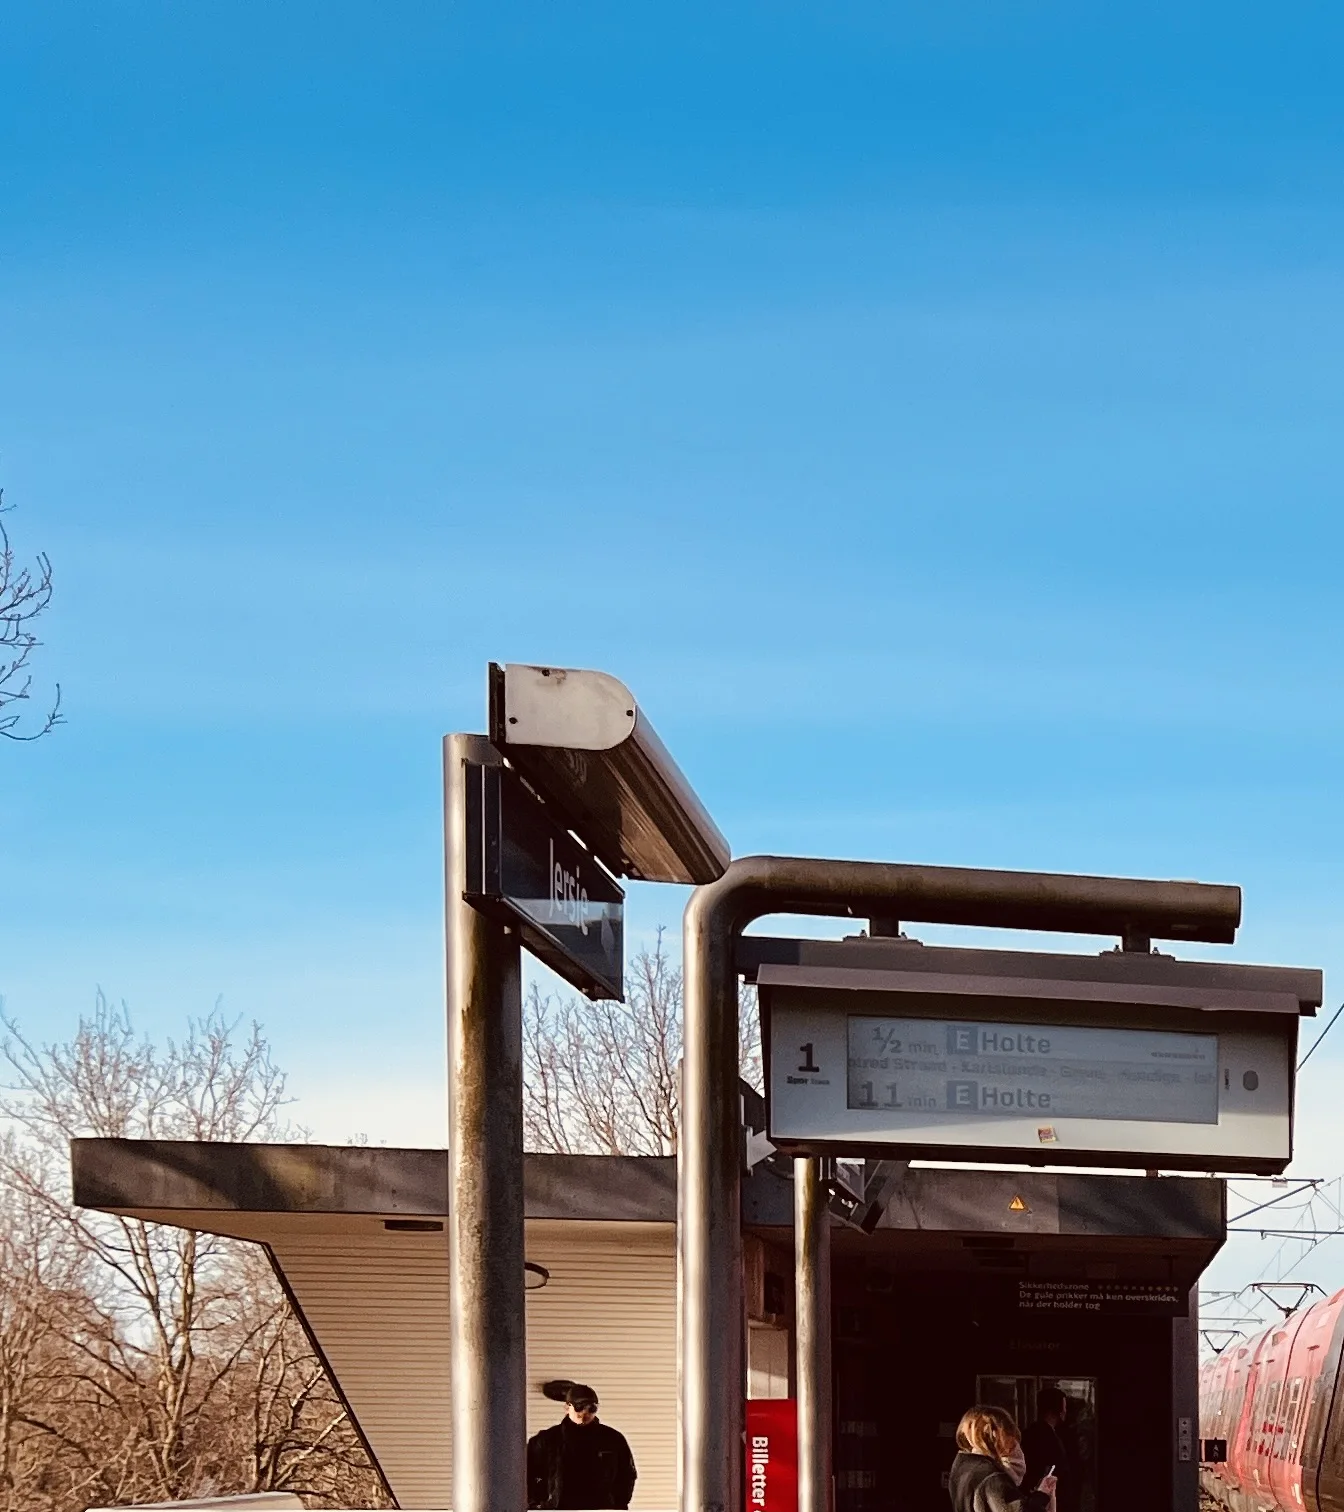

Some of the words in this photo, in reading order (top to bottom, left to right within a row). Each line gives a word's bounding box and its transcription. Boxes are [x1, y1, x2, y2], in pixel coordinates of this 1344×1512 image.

[549, 838, 588, 936] Jersie
[956, 1030, 970, 1050] E
[982, 1032, 1050, 1053] Holte
[798, 1043, 820, 1072] 1
[956, 1085, 970, 1104] E
[982, 1086, 1050, 1108] Holte
[1019, 1281, 1089, 1291] Sikkerhedszone
[1019, 1291, 1031, 1299] De
[1034, 1291, 1053, 1301] gule
[1056, 1291, 1088, 1301] prikker
[1090, 1292, 1104, 1300] må
[1106, 1293, 1123, 1301] kun
[1036, 1300, 1051, 1308] der
[1053, 1300, 1082, 1309] holder
[1085, 1301, 1101, 1311] tog
[752, 1436, 769, 1507] Billetter
